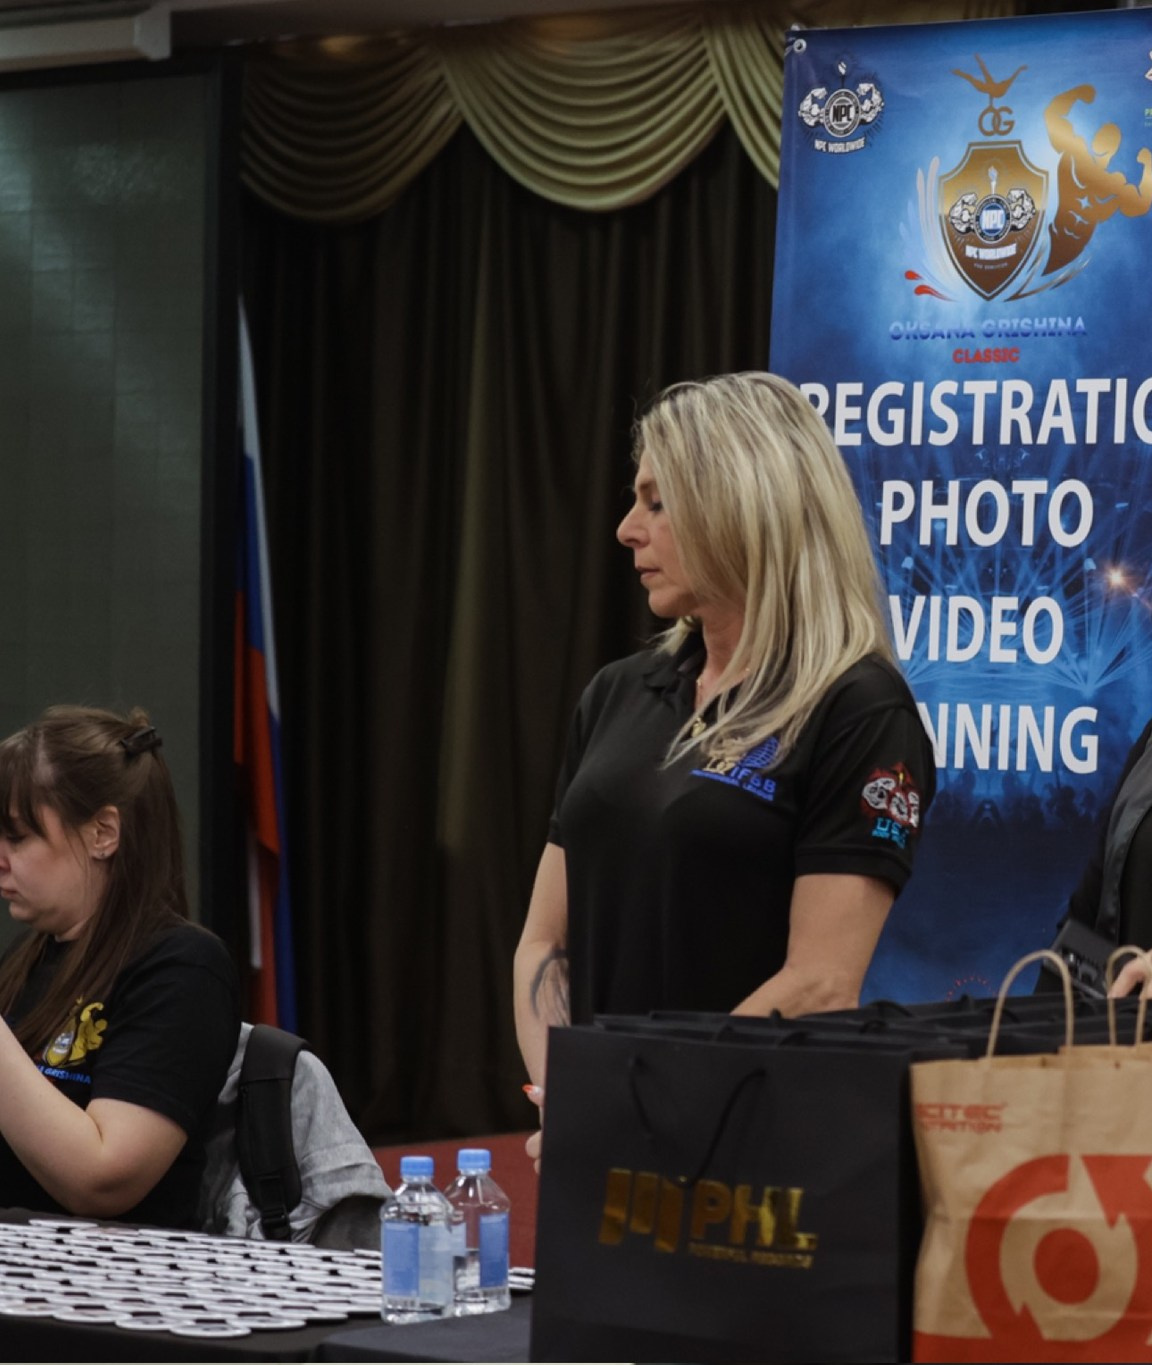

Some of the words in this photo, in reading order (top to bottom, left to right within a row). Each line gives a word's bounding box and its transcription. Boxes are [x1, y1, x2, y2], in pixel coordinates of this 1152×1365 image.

[832, 104, 853, 123] NPC
[983, 208, 1005, 230] NPC
[889, 321, 975, 341] OKSANA
[982, 316, 1087, 338] GRISHINA
[952, 347, 1020, 363] CLASSIC
[879, 479, 1094, 548] PHOTO
[889, 595, 1064, 665] VIDEO
[917, 702, 1099, 774] NNING
